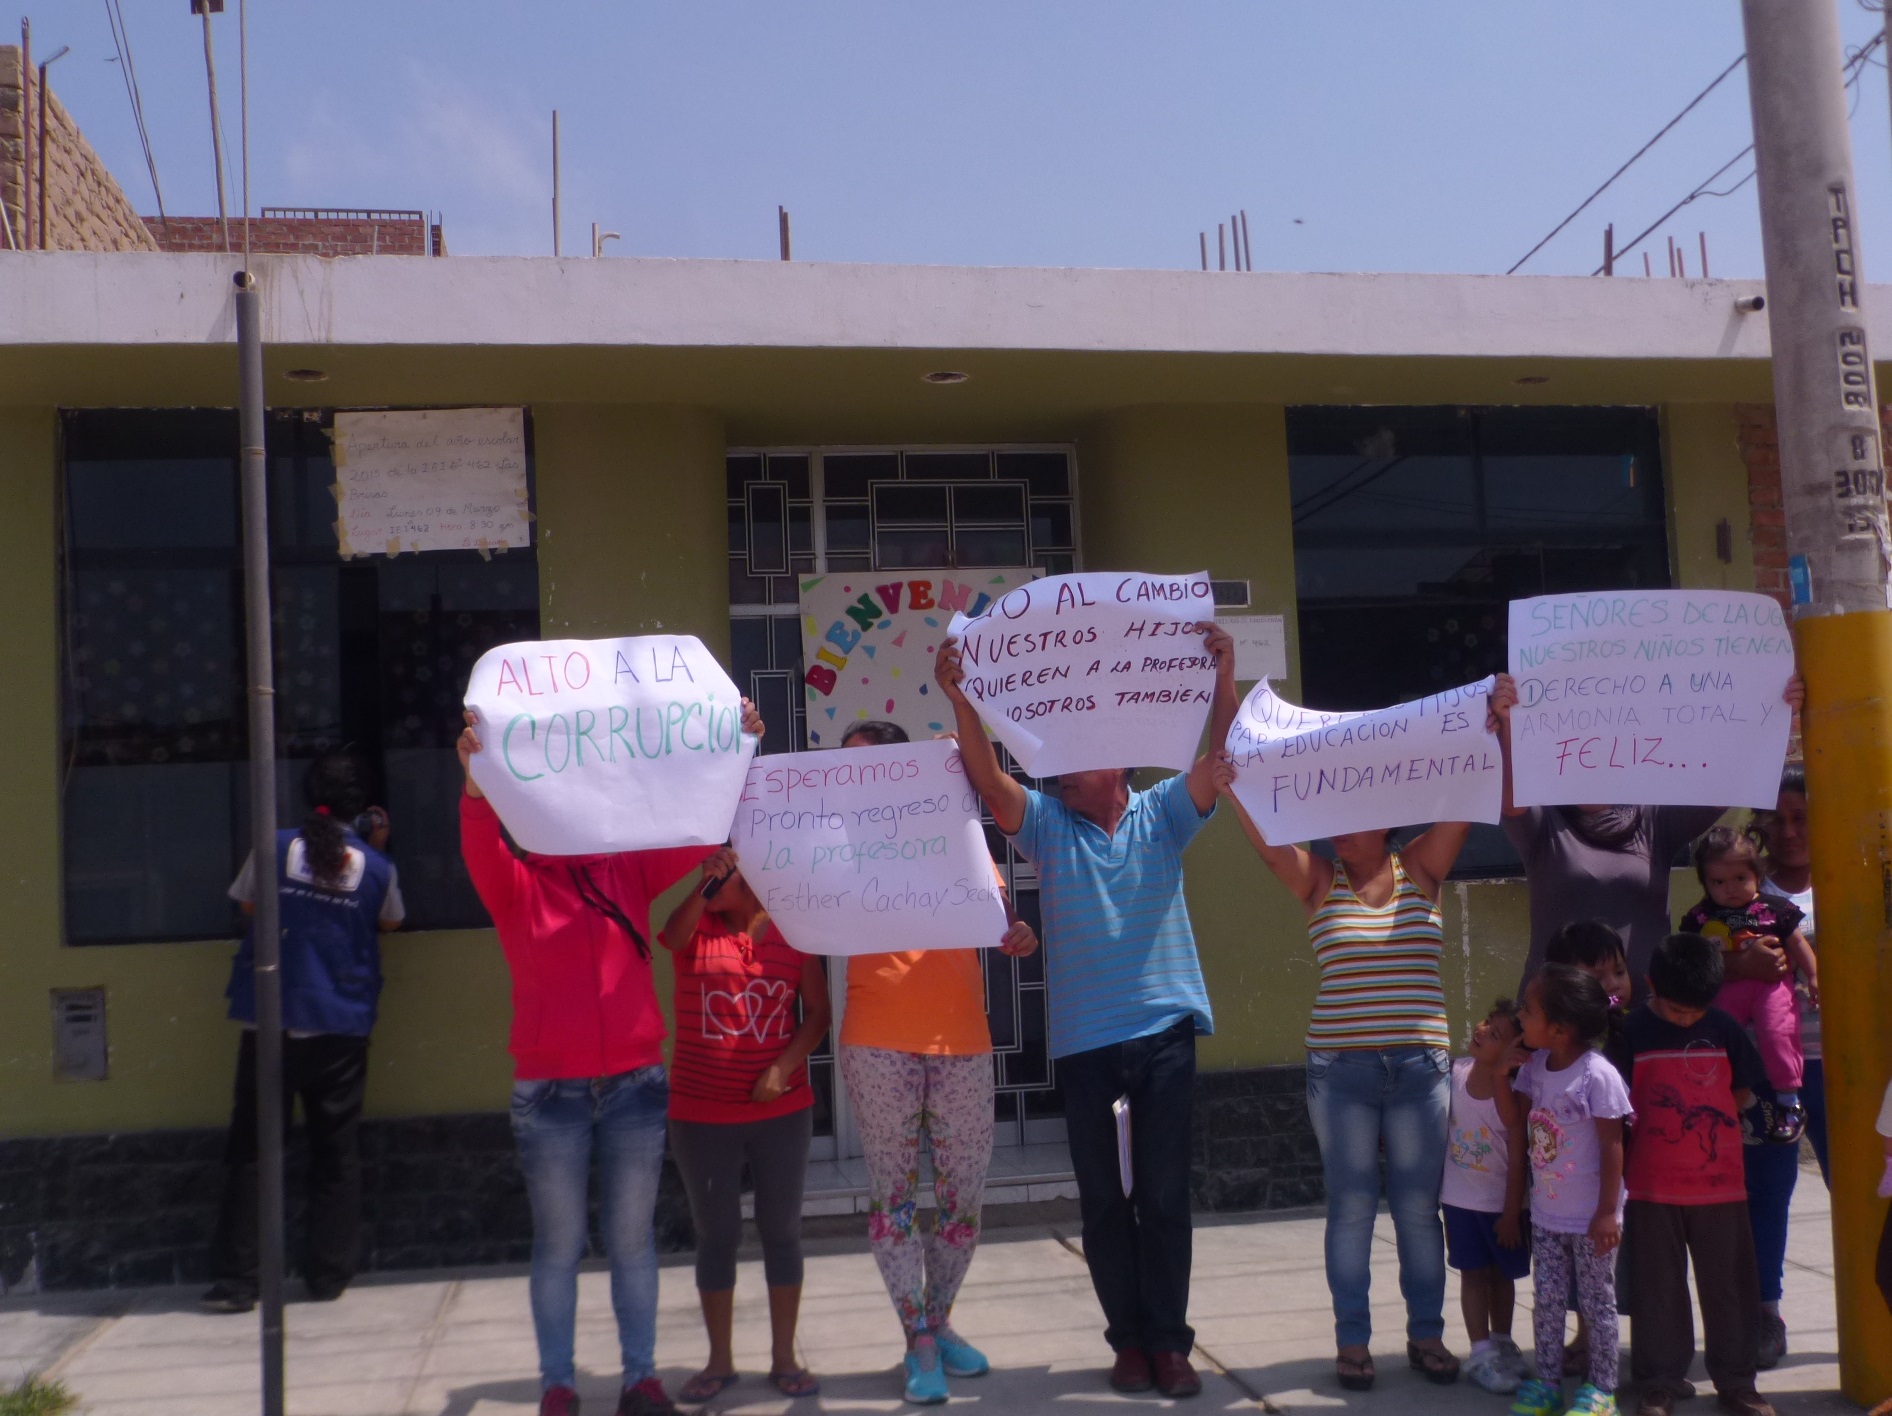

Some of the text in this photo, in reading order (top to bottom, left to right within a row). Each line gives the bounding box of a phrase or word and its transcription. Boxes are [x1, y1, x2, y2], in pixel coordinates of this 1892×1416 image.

[1839, 331, 1868, 406] 2008
[1056, 582, 1096, 615] AL
[1531, 595, 1669, 637] SEÑORES
[1683, 601, 1719, 626] DE
[1723, 603, 1749, 626] LA
[804, 579, 991, 697] BIENVENI
[958, 626, 1098, 668] NUESTROS
[1519, 638, 1627, 673] NUESTROS
[497, 645, 694, 696] ALTO A LA
[965, 656, 1217, 702] QUIEREN A LA PROFESORA
[1520, 672, 1734, 709] DERECHO A UNA
[1230, 746, 1265, 769] LA
[1441, 711, 1470, 735] ES
[1519, 703, 1774, 741] ARMONIA TOTAL Y
[740, 755, 964, 802] Esperamos e
[1271, 753, 1495, 813] FUNDAMENTAL
[851, 793, 949, 840] regreso
[811, 835, 947, 874] profesora
[767, 874, 1001, 917] Esther Cachay Secle
